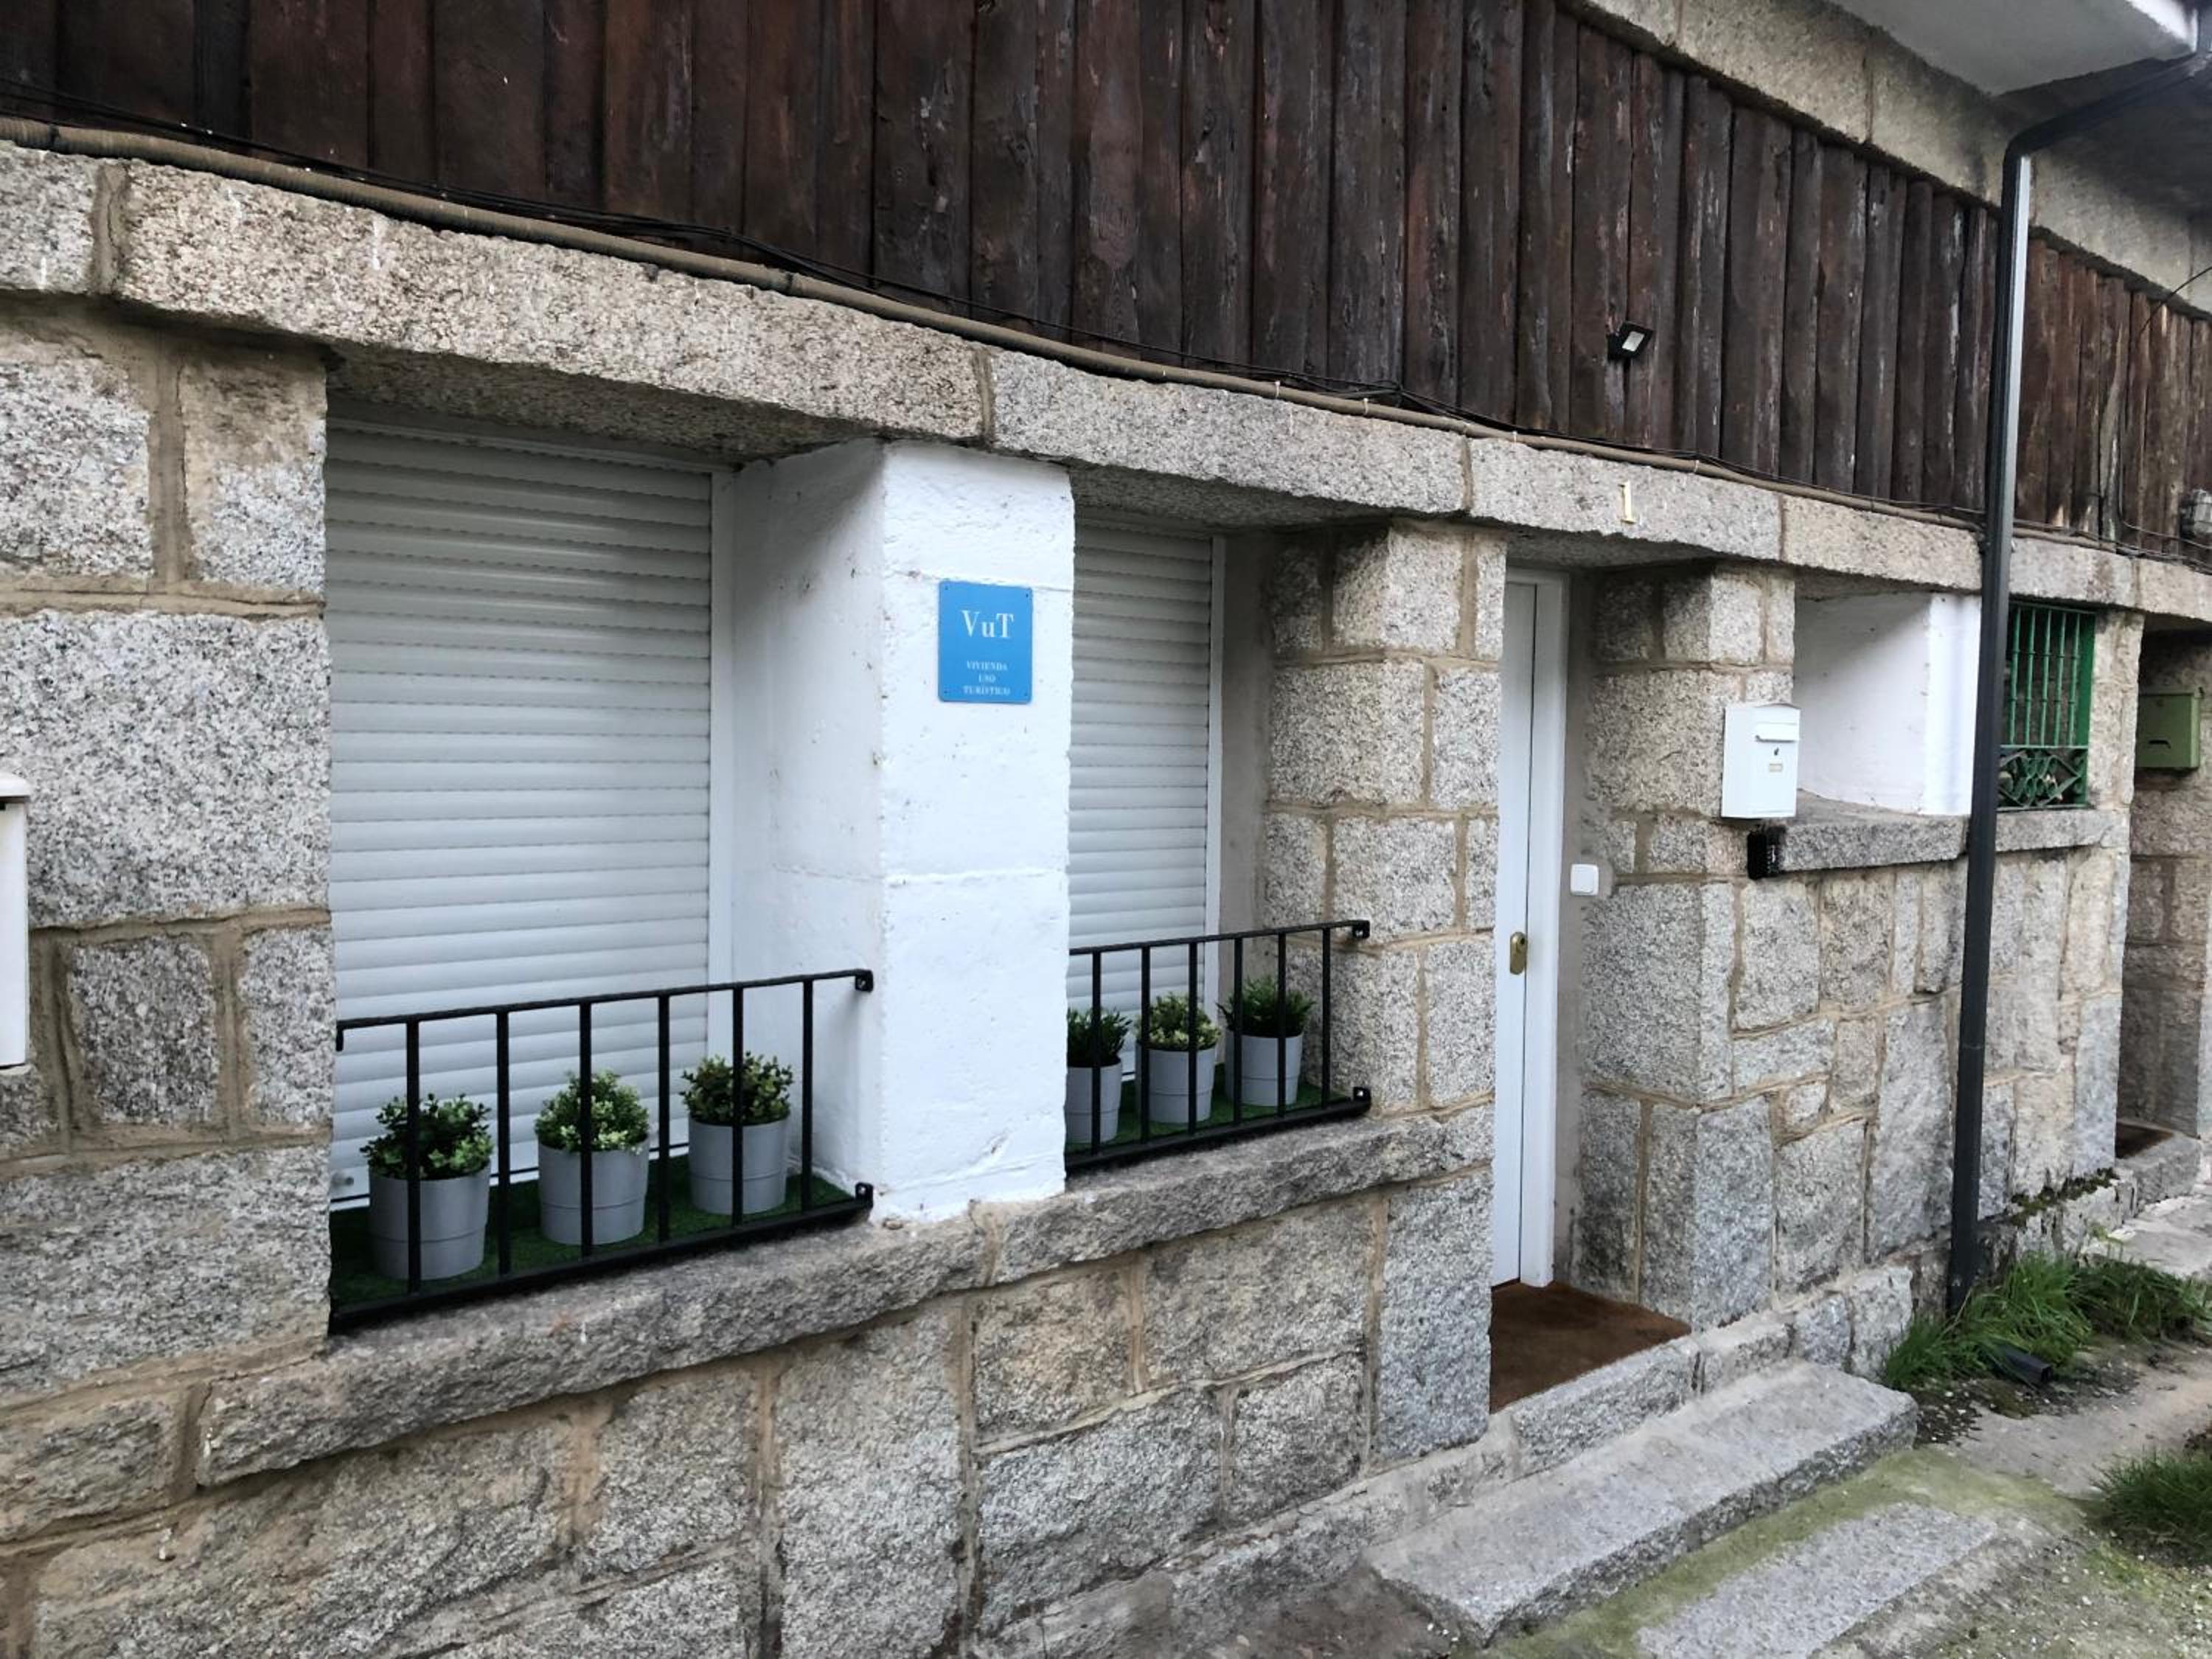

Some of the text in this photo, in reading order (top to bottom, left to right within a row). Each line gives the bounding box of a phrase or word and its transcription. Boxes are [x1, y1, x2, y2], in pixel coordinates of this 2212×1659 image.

[1617, 481, 1636, 524] 1
[961, 611, 1015, 638] VuT
[967, 661, 1008, 671] VIVIENDA
[978, 674, 997, 684] USO
